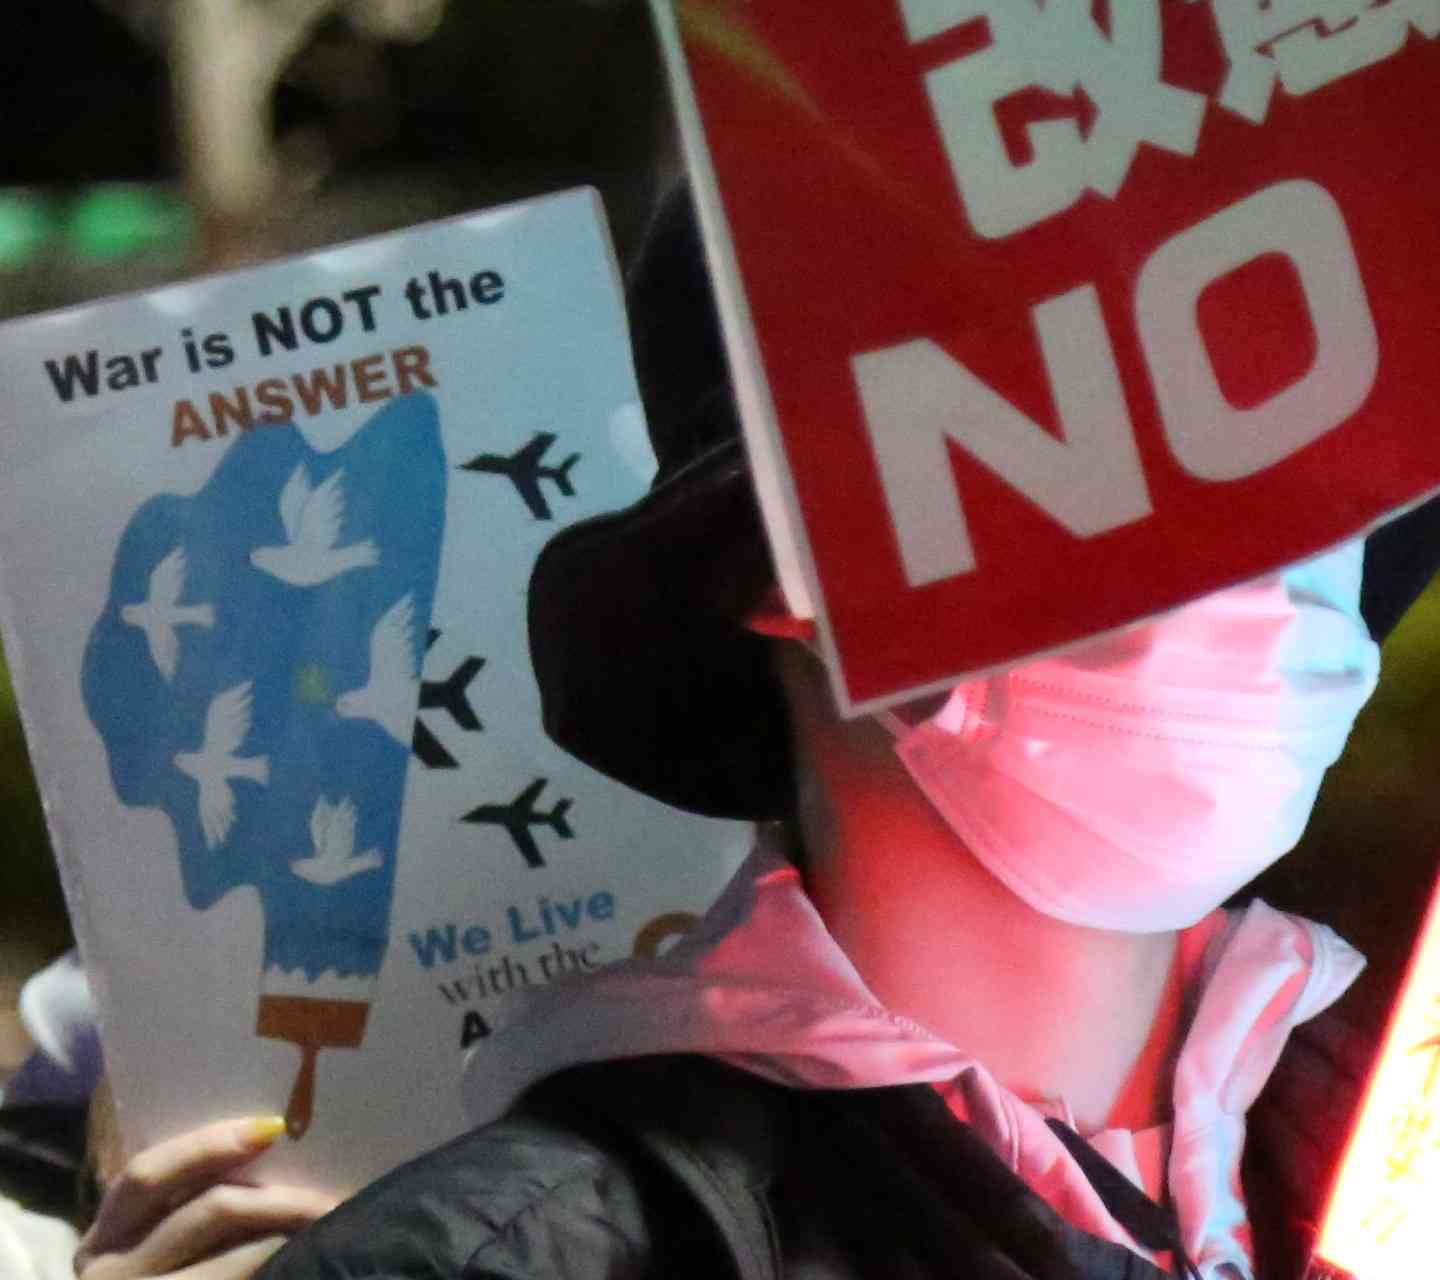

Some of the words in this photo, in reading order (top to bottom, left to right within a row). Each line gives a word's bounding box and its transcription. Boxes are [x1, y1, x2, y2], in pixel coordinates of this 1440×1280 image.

[43, 347, 163, 403] War
[180, 327, 235, 374] is
[250, 284, 383, 358] NOT
[403, 267, 507, 320] the
[851, 177, 1380, 588] NO
[170, 344, 440, 448] ANSWER
[409, 923, 493, 970] We
[506, 889, 616, 945] Live
